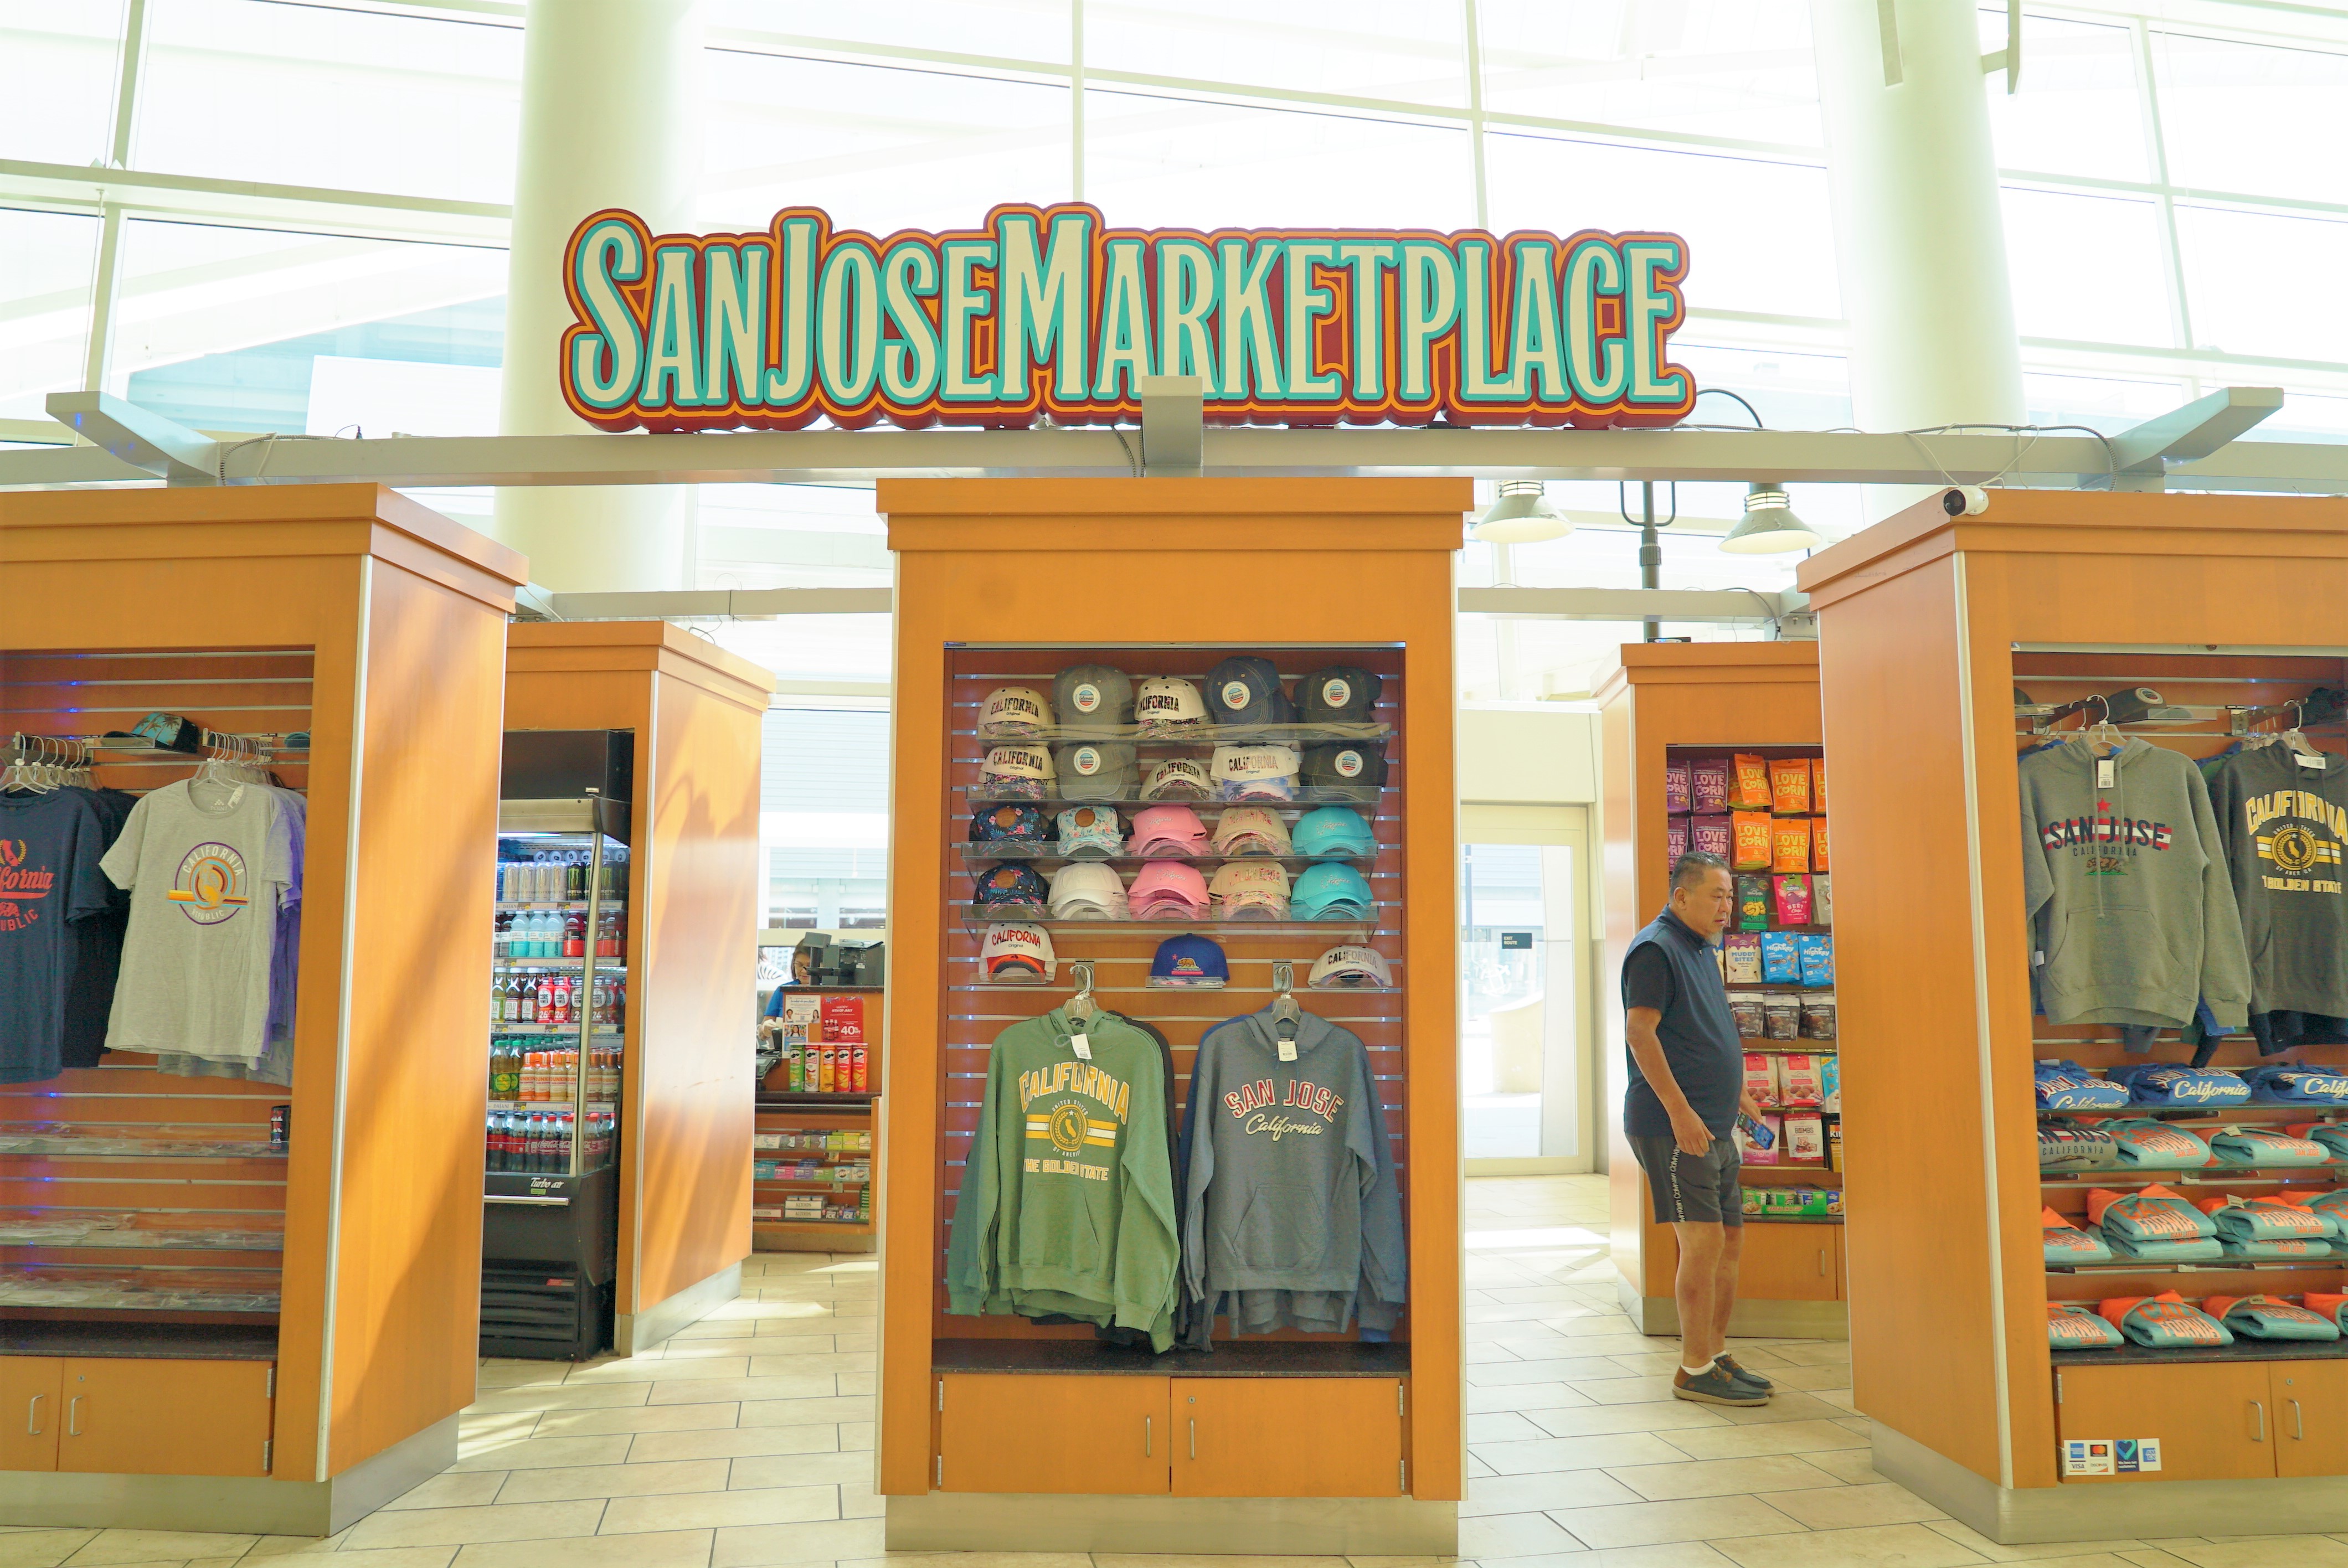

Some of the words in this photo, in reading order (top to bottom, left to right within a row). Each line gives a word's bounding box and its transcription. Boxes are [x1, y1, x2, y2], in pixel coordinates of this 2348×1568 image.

[991, 698, 1039, 718] CALIFORNIA
[993, 751, 1043, 772] CALIFORNIA
[1229, 755, 1279, 772] CALIFORNIA
[1696, 785, 1724, 796] CORN
[1777, 785, 1806, 797] CORN
[1738, 836, 1768, 848] CORN
[2049, 816, 2093, 849] SAN
[2106, 816, 2166, 851] JOSE
[1698, 842, 1727, 853] CORN
[1777, 845, 1806, 857] CORN
[183, 845, 245, 876] CALIFORNIA
[0, 909, 39, 932] UBLIC
[992, 930, 1041, 949] CALIFORNIA
[1328, 950, 1377, 969] CALIFORNIA
[574, 1010, 580, 1019] 2
[1018, 1061, 1130, 1125] CALIFORNIA
[2076, 1078, 2129, 1096] JOS
[2174, 1080, 2251, 1103] California
[1051, 1099, 1070, 1112] UNITED
[1224, 1078, 1276, 1119] SAN
[1283, 1079, 1345, 1123] JOSE
[1245, 1113, 1325, 1142] California
[2042, 1144, 2104, 1156] CALIFORNIA
[531, 1177, 551, 1188] Turbo
